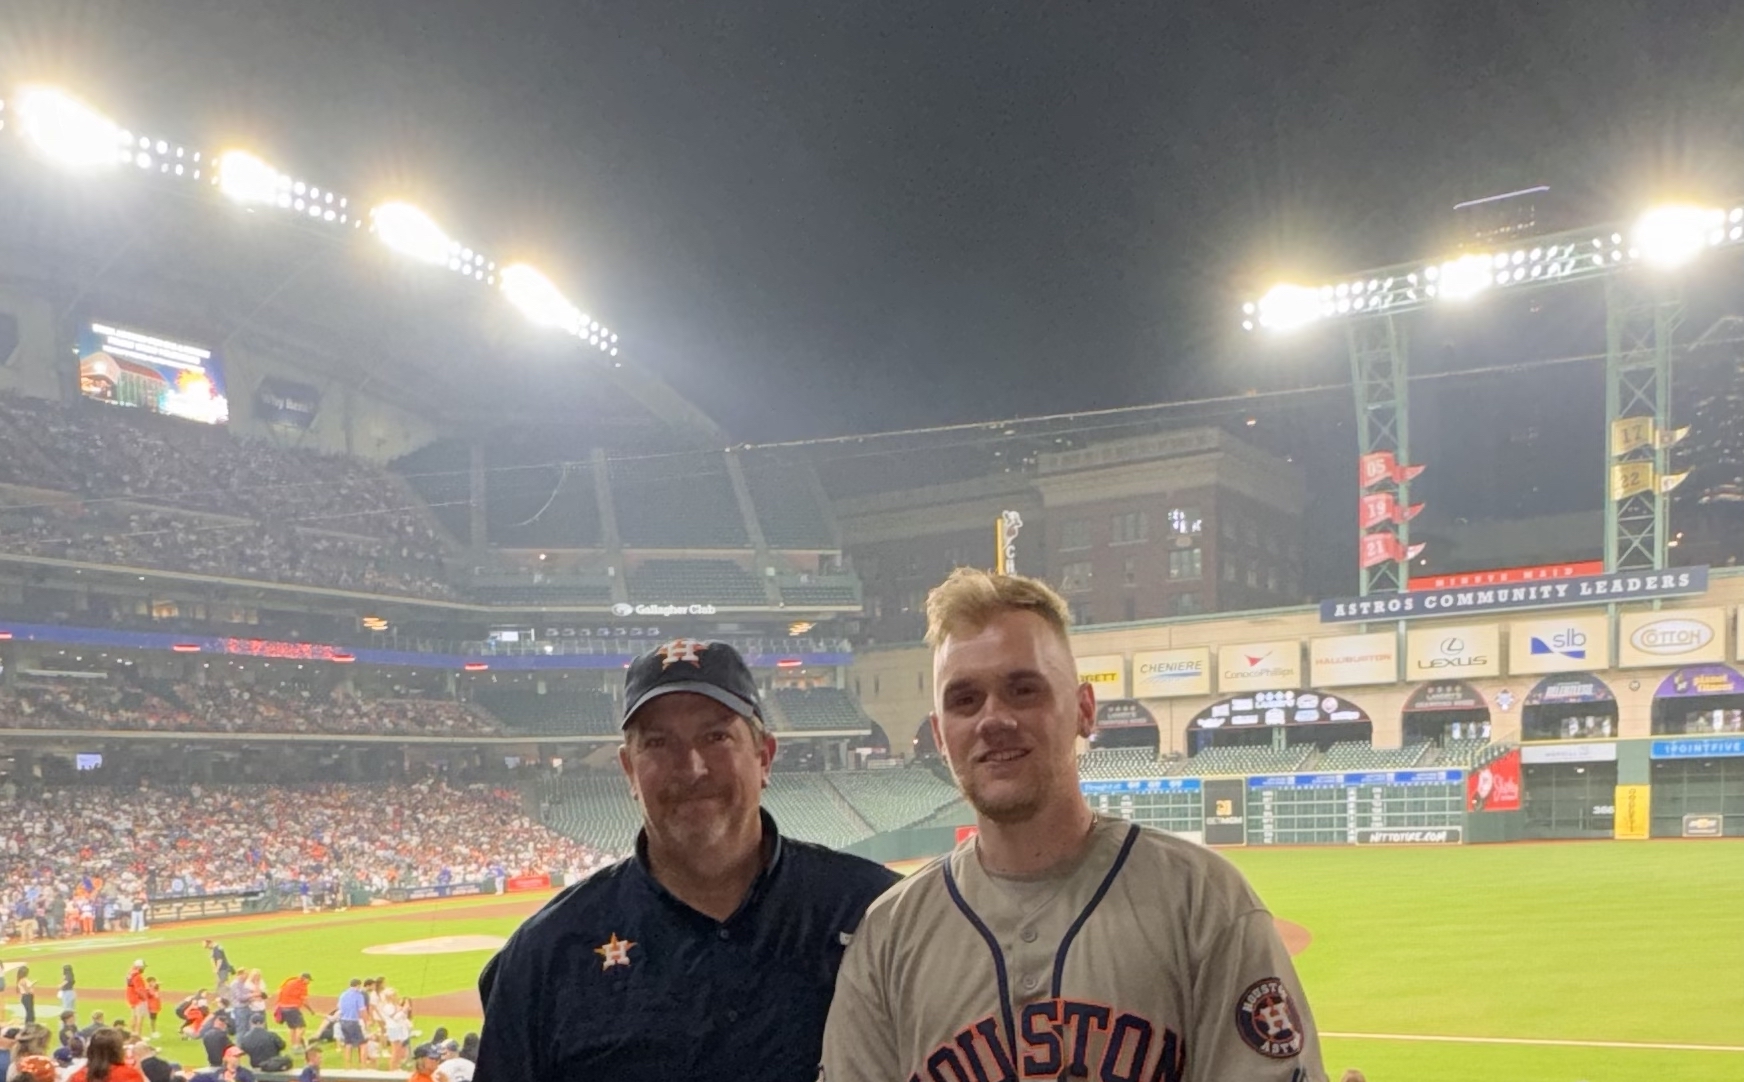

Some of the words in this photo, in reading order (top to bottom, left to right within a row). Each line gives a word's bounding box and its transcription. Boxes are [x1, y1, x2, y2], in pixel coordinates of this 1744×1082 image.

[1366, 459, 1386, 477] 05
[1621, 471, 1640, 489] 22
[1367, 501, 1386, 519] 19
[1366, 540, 1384, 557] 21
[1434, 572, 1509, 587] MINUTE
[1522, 567, 1574, 579] MAID
[1334, 598, 1414, 617] ASTROS
[1424, 584, 1570, 610] COMMUNITY
[1579, 573, 1691, 597] LEADERS
[635, 604, 688, 616] Gallagher
[689, 604, 716, 615] Club
[1552, 627, 1587, 649] slb
[1640, 623, 1701, 647] COTTON
[1140, 660, 1202, 674] CHENIERE
[1417, 655, 1487, 670] LEXUS
[1224, 667, 1295, 680] ConocoPhillips
